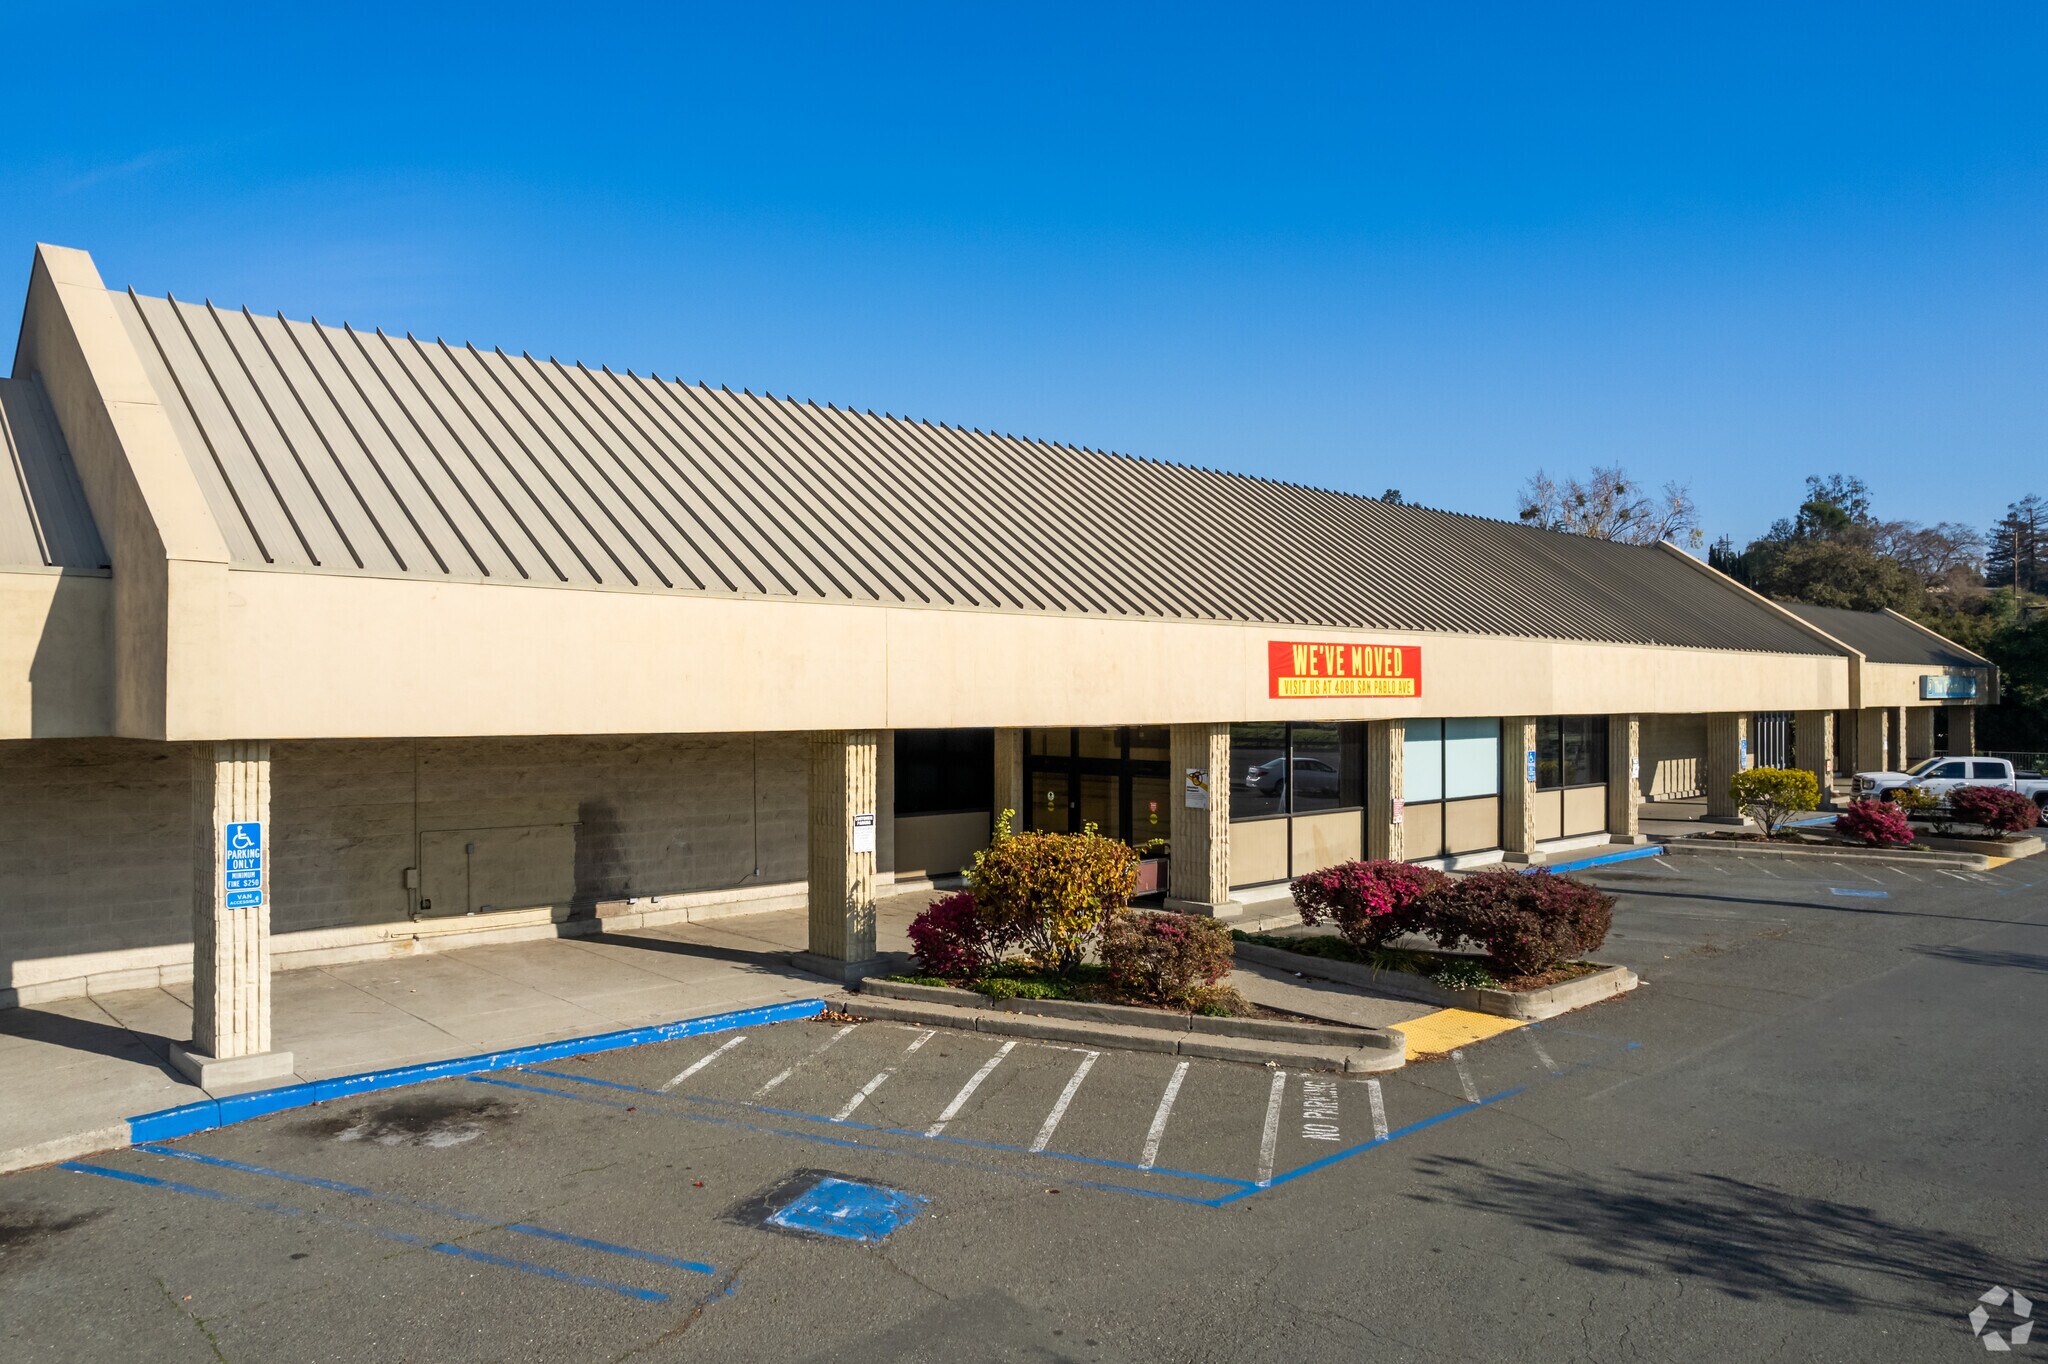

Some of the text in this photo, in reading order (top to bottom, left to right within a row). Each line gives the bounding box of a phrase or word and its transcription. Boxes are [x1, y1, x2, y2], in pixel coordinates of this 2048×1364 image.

[1293, 644, 1402, 676] WE'VE MOVED
[1284, 679, 1411, 694] VISIT US AT 4080 SAN PABLO AVE
[227, 848, 260, 860] PARKING
[232, 859, 254, 869] ONLY
[231, 871, 256, 879] MINIMUM
[227, 878, 260, 888] FINE $250
[1302, 1123, 1341, 1141] NO
